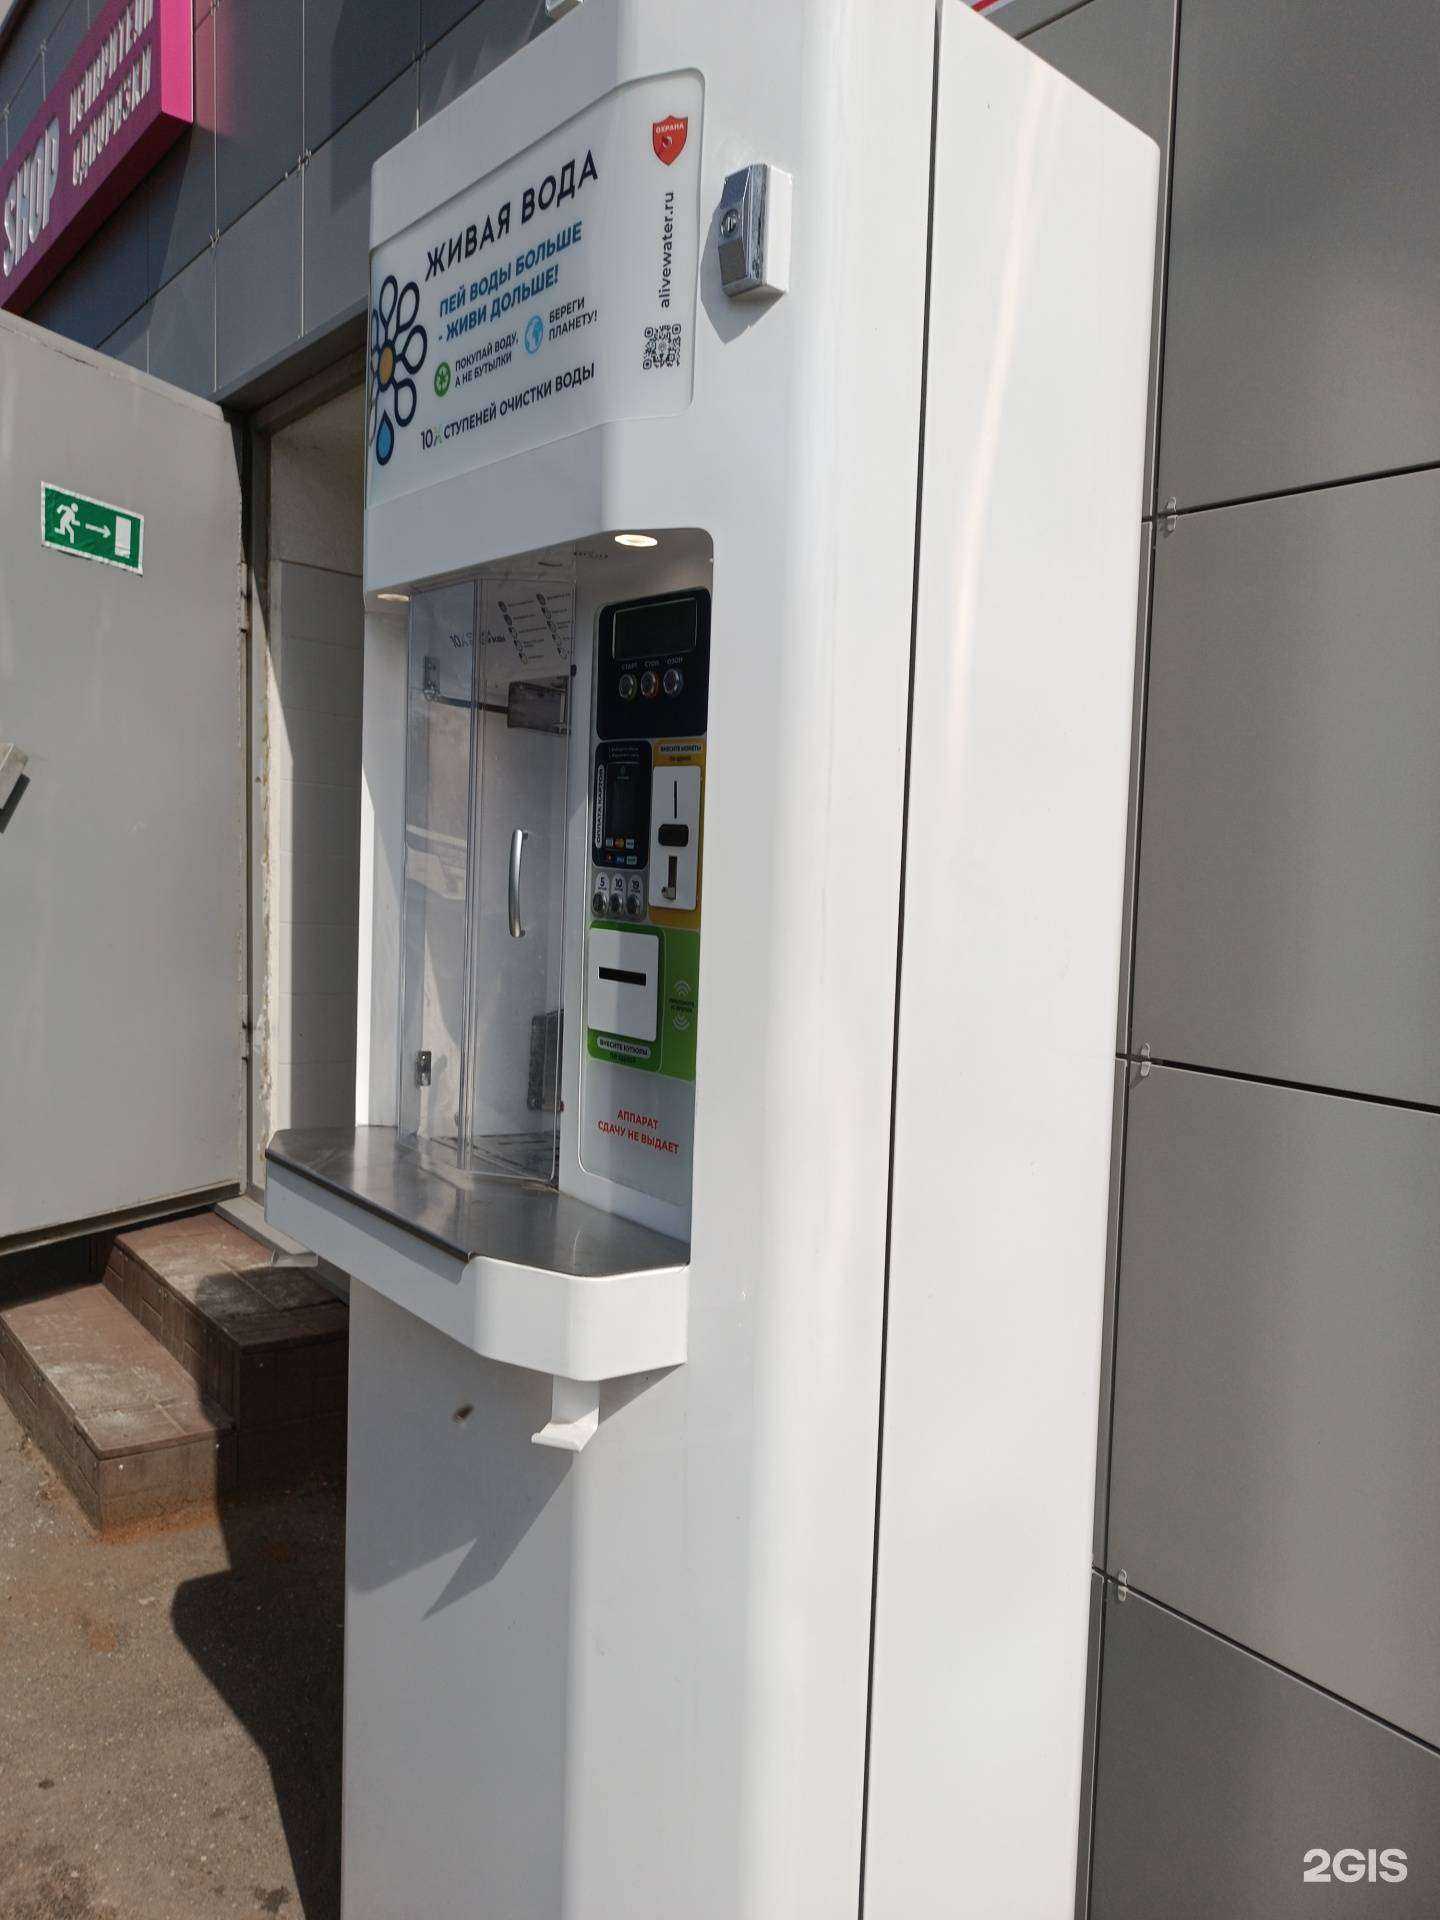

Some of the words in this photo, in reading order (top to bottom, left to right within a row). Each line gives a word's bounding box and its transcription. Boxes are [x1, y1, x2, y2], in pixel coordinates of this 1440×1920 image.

[655, 122, 684, 134] ОХРАНА
[3, 116, 60, 278] SHOP
[425, 201, 511, 282] ЖИВАЯ
[521, 149, 598, 225] ВОДА
[659, 191, 674, 309] alivewater.ru
[440, 285, 466, 318] ПЕЙ
[470, 262, 512, 302] ВОДЫ
[515, 221, 582, 277] БОЛЬШЕ
[446, 305, 487, 342] ЖИВИ
[490, 264, 559, 322] ДОЛЬШЕ!
[549, 297, 585, 323] БЕРЕГИ
[549, 310, 598, 341] ПЛАНЕТУ!
[455, 342, 493, 372] ПОКУПАЙ
[455, 375, 461, 388] А
[462, 371, 473, 386] НЕ
[474, 351, 512, 381] БУТЫЛКИ
[443, 402, 497, 439] СТУПЕНЕЙ
[500, 379, 552, 416] ОЧИСТКИ
[555, 362, 595, 392] ВОДЫ
[599, 877, 605, 887] 5
[615, 878, 623, 888] 10
[632, 880, 640, 889] 19
[617, 1109, 659, 1130] АППАРАТ
[598, 1121, 626, 1137] СДАЧУ
[628, 1130, 639, 1141] НЕ
[641, 1134, 680, 1154] ВЫДАЕТ
